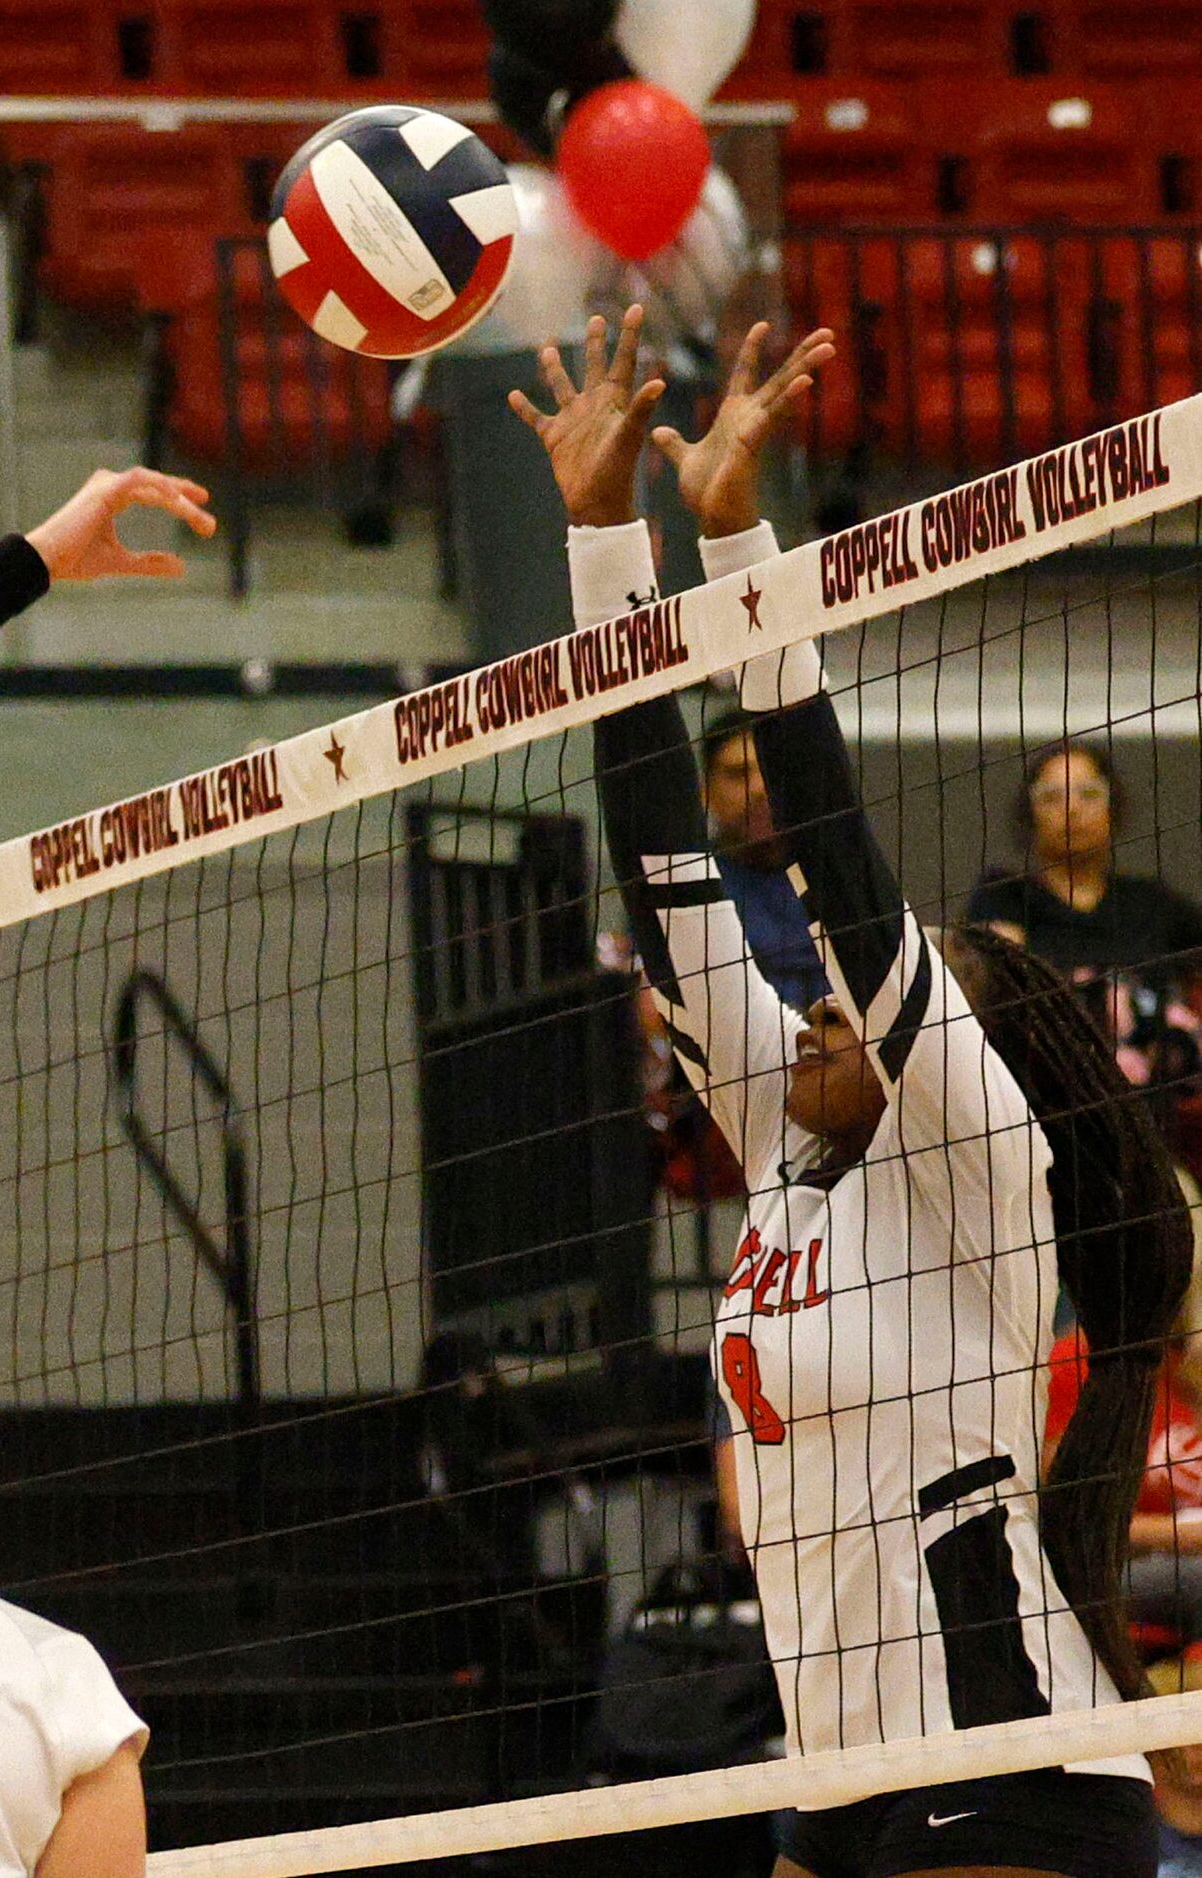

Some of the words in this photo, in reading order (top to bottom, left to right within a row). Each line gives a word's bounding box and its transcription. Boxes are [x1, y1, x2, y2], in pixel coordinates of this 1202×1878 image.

[820, 510, 919, 609] COPPELL
[921, 469, 1026, 573] COWGIRL
[1026, 413, 1170, 532] VOLLEYBALL
[394, 678, 473, 764] COPPELL
[475, 642, 569, 734] COWGIRL
[567, 596, 689, 701] VOLLEYBALL
[30, 815, 100, 893] COPPELL
[100, 787, 178, 868] COWGIRL
[179, 748, 283, 840] VOLLEYBALL
